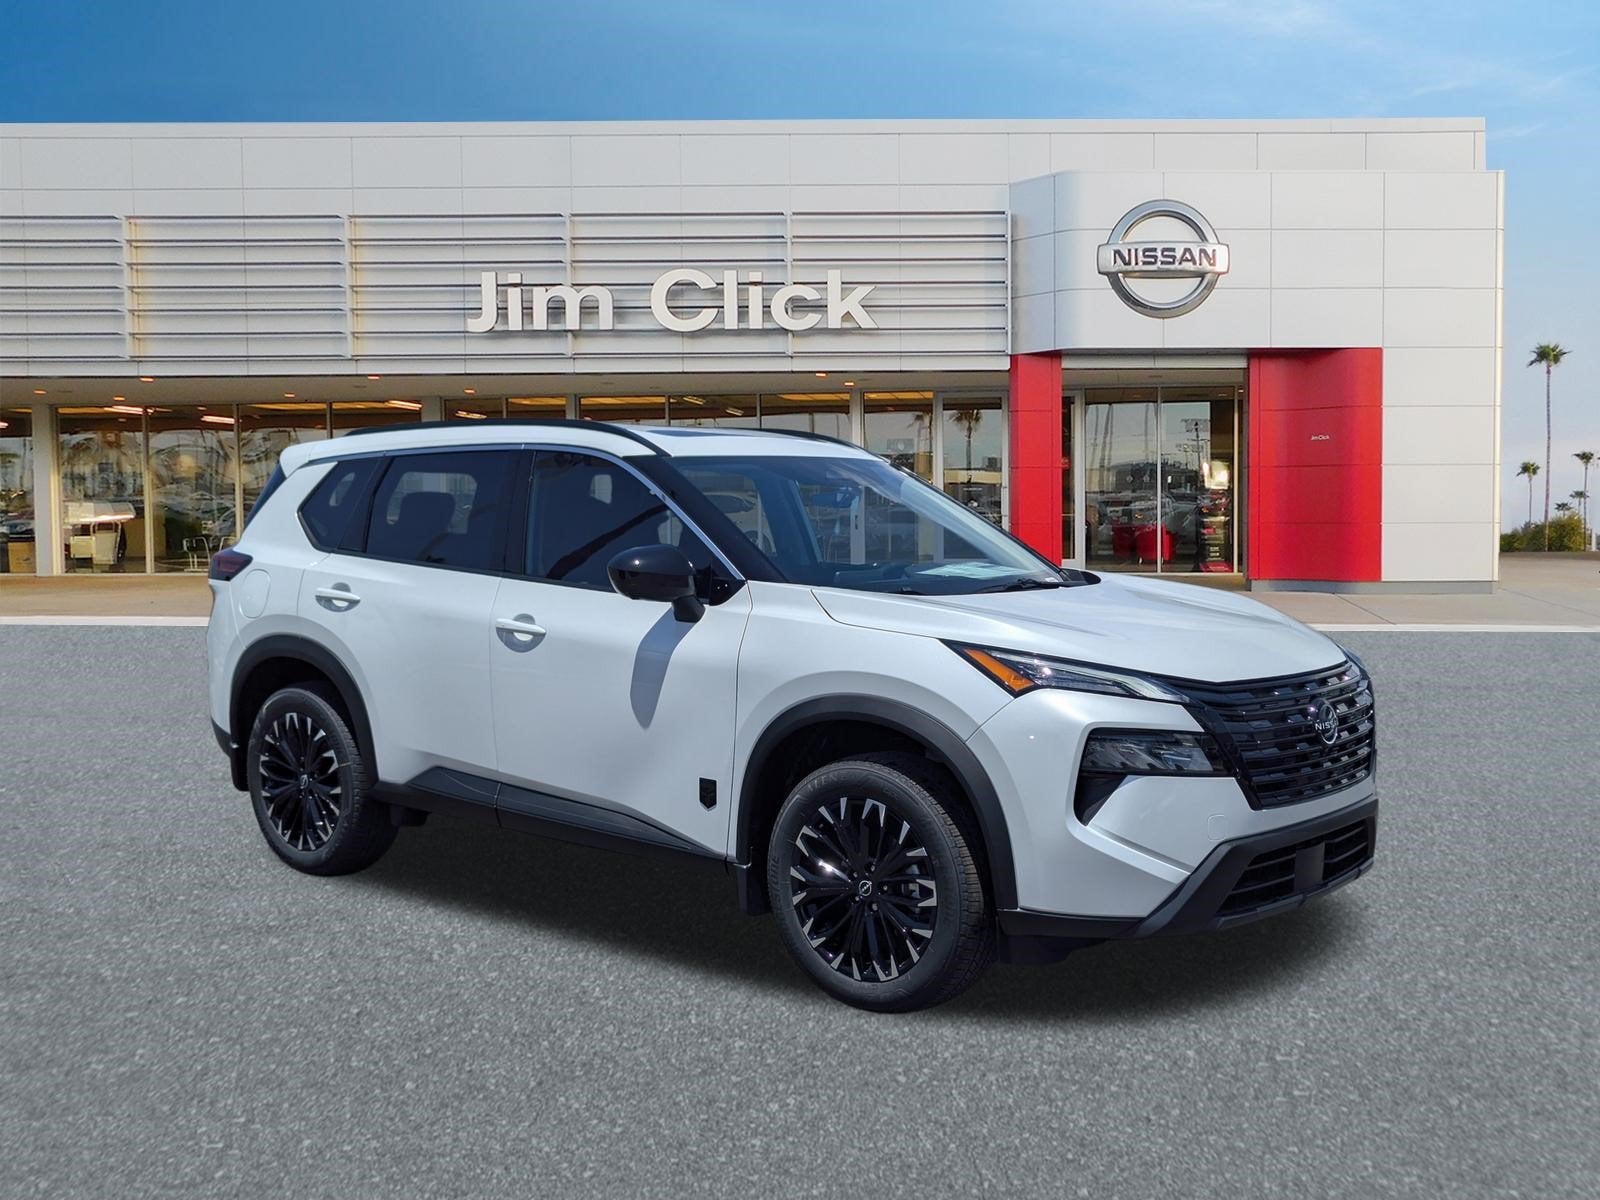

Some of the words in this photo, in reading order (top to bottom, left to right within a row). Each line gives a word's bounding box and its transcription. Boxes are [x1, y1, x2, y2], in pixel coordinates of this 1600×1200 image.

[1113, 247, 1217, 267] NISSAN
[466, 271, 614, 333] Jim
[650, 268, 880, 332] Click
